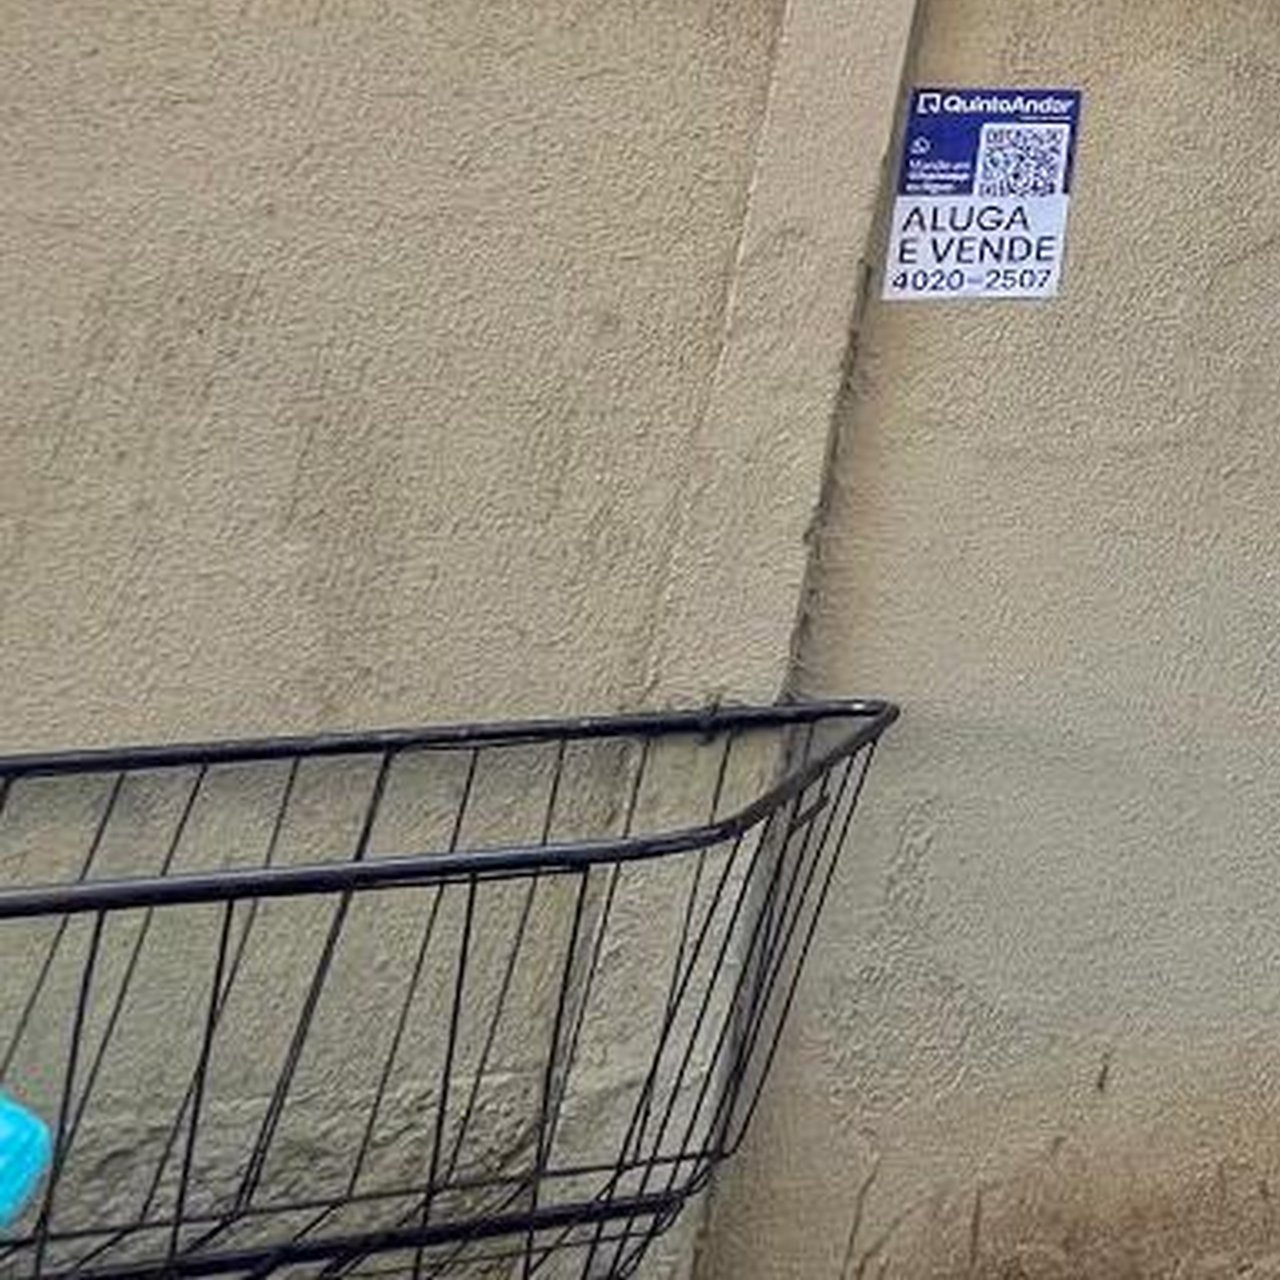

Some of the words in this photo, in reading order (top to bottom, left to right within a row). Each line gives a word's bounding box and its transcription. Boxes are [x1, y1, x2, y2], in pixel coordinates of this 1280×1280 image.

[943, 94, 1074, 114] QuintoAndar
[902, 206, 1030, 232] ALUGA
[898, 237, 917, 264] E
[932, 236, 1056, 263] VENDE
[892, 269, 1052, 291] 4020-2507
